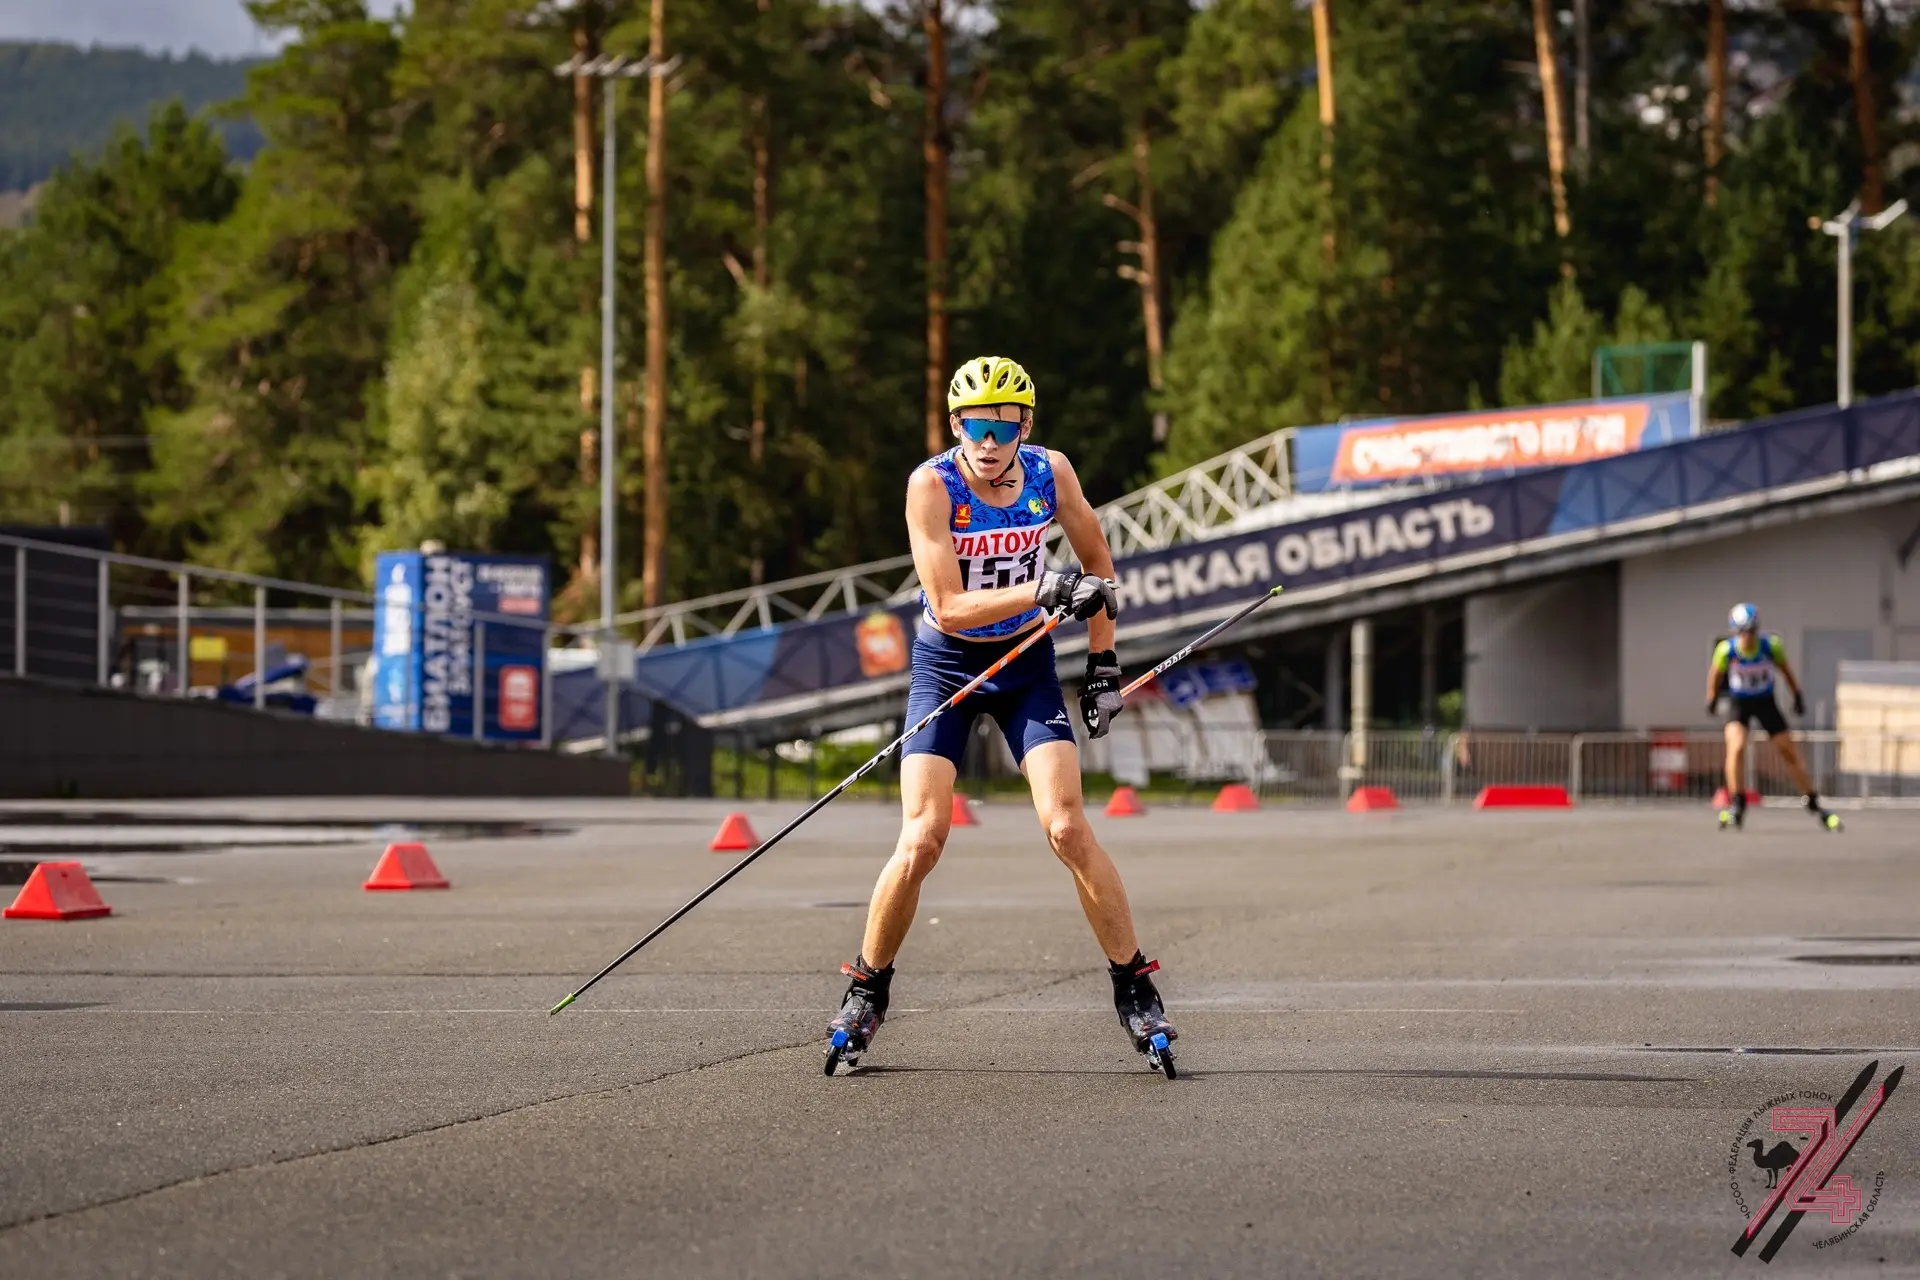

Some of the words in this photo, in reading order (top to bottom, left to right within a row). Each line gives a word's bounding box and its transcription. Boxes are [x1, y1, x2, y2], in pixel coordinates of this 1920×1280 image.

[952, 523, 1050, 557] ЛАТОУС
[1275, 498, 1494, 575] ОБЛАСТЬ
[422, 556, 450, 732] БИАТЛОН
